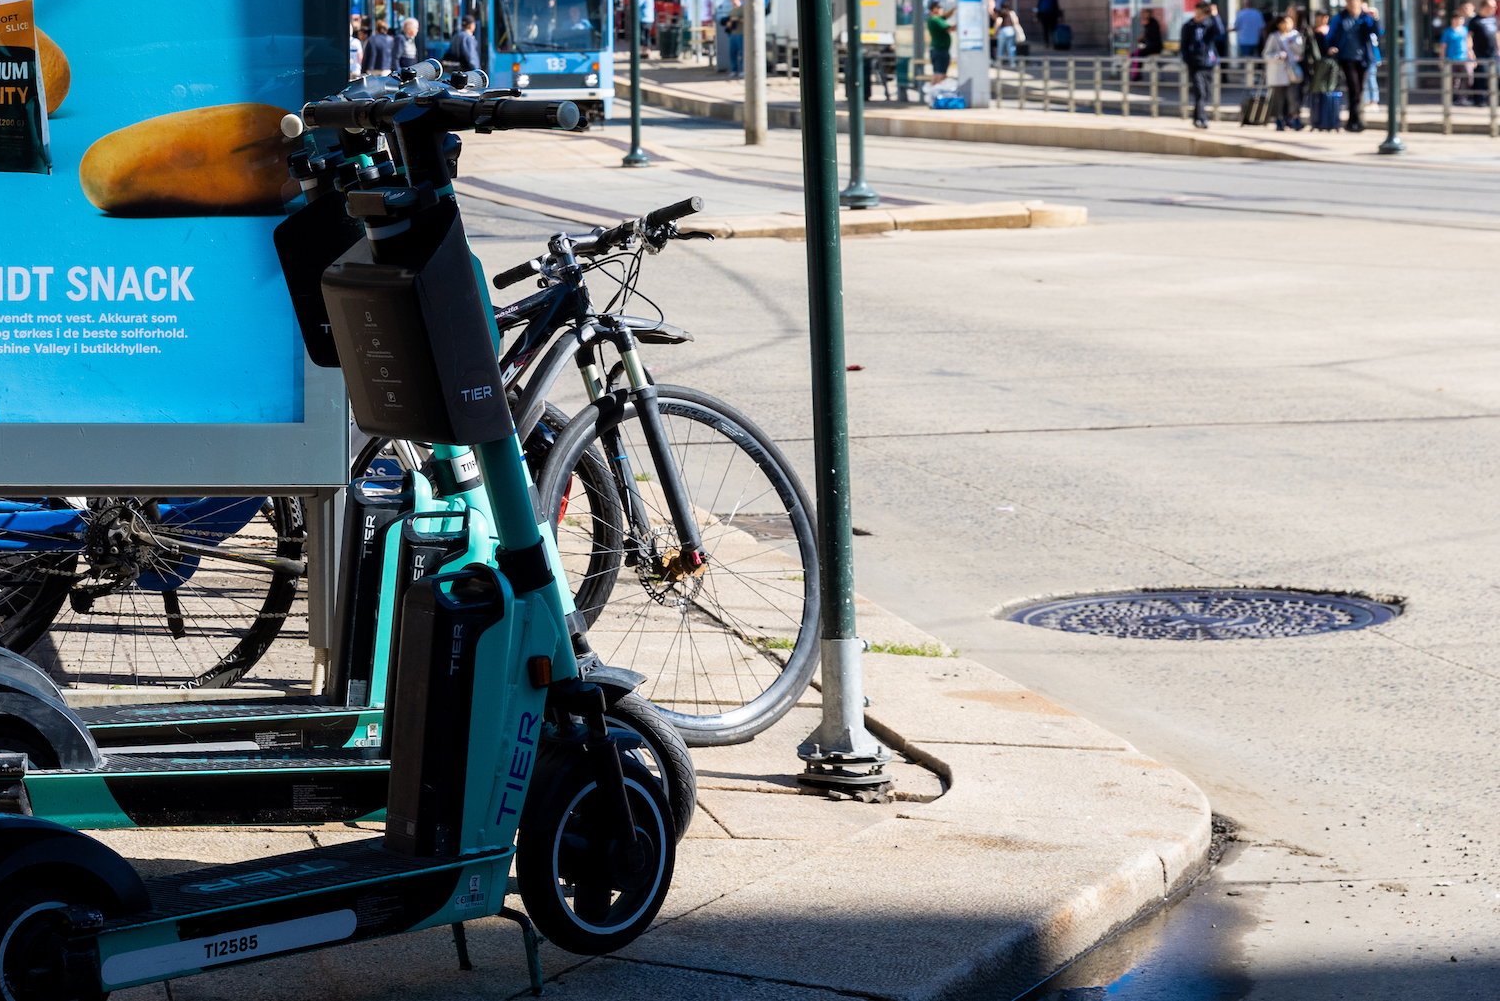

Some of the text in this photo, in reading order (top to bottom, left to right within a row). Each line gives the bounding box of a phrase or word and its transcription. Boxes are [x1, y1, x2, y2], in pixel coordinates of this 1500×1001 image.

[66, 266, 195, 301] SNACK
[37, 314, 62, 323] mot
[66, 314, 95, 323] vest.
[99, 313, 148, 323] Akkurat
[151, 315, 177, 323] som
[14, 328, 52, 338] tørkes
[56, 327, 60, 338] i
[63, 328, 79, 338] de
[83, 328, 118, 338] beste
[121, 327, 188, 338] solforhold.
[34, 343, 71, 355] Valley
[74, 342, 78, 353] i
[81, 342, 161, 355] butikkhyllen.
[460, 384, 493, 402] TIER
[362, 515, 377, 559] TIER
[413, 554, 426, 581] ER
[450, 623, 464, 676] TIER
[496, 711, 539, 826] TIER
[197, 862, 338, 894] TIER
[203, 933, 259, 959] TI2585
